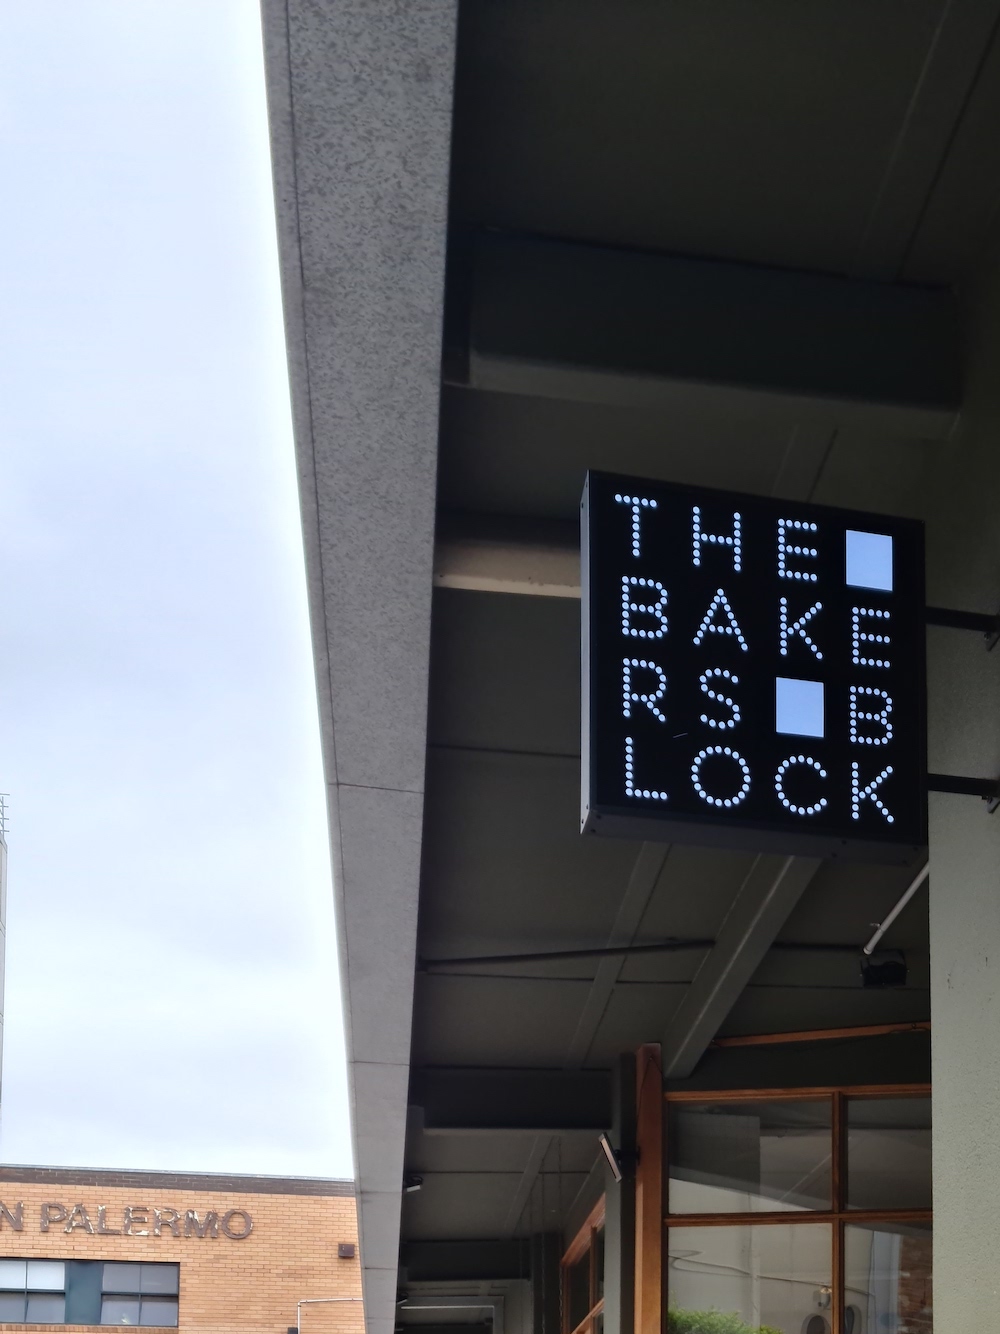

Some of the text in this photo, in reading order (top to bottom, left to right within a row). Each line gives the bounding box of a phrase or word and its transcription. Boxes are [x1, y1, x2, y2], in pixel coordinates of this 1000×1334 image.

[614, 493, 818, 582] THE
[621, 575, 891, 668] BAKE
[622, 658, 893, 745] RS B
[625, 736, 895, 823] LOCK
[40, 1202, 253, 1240] PALERMO
